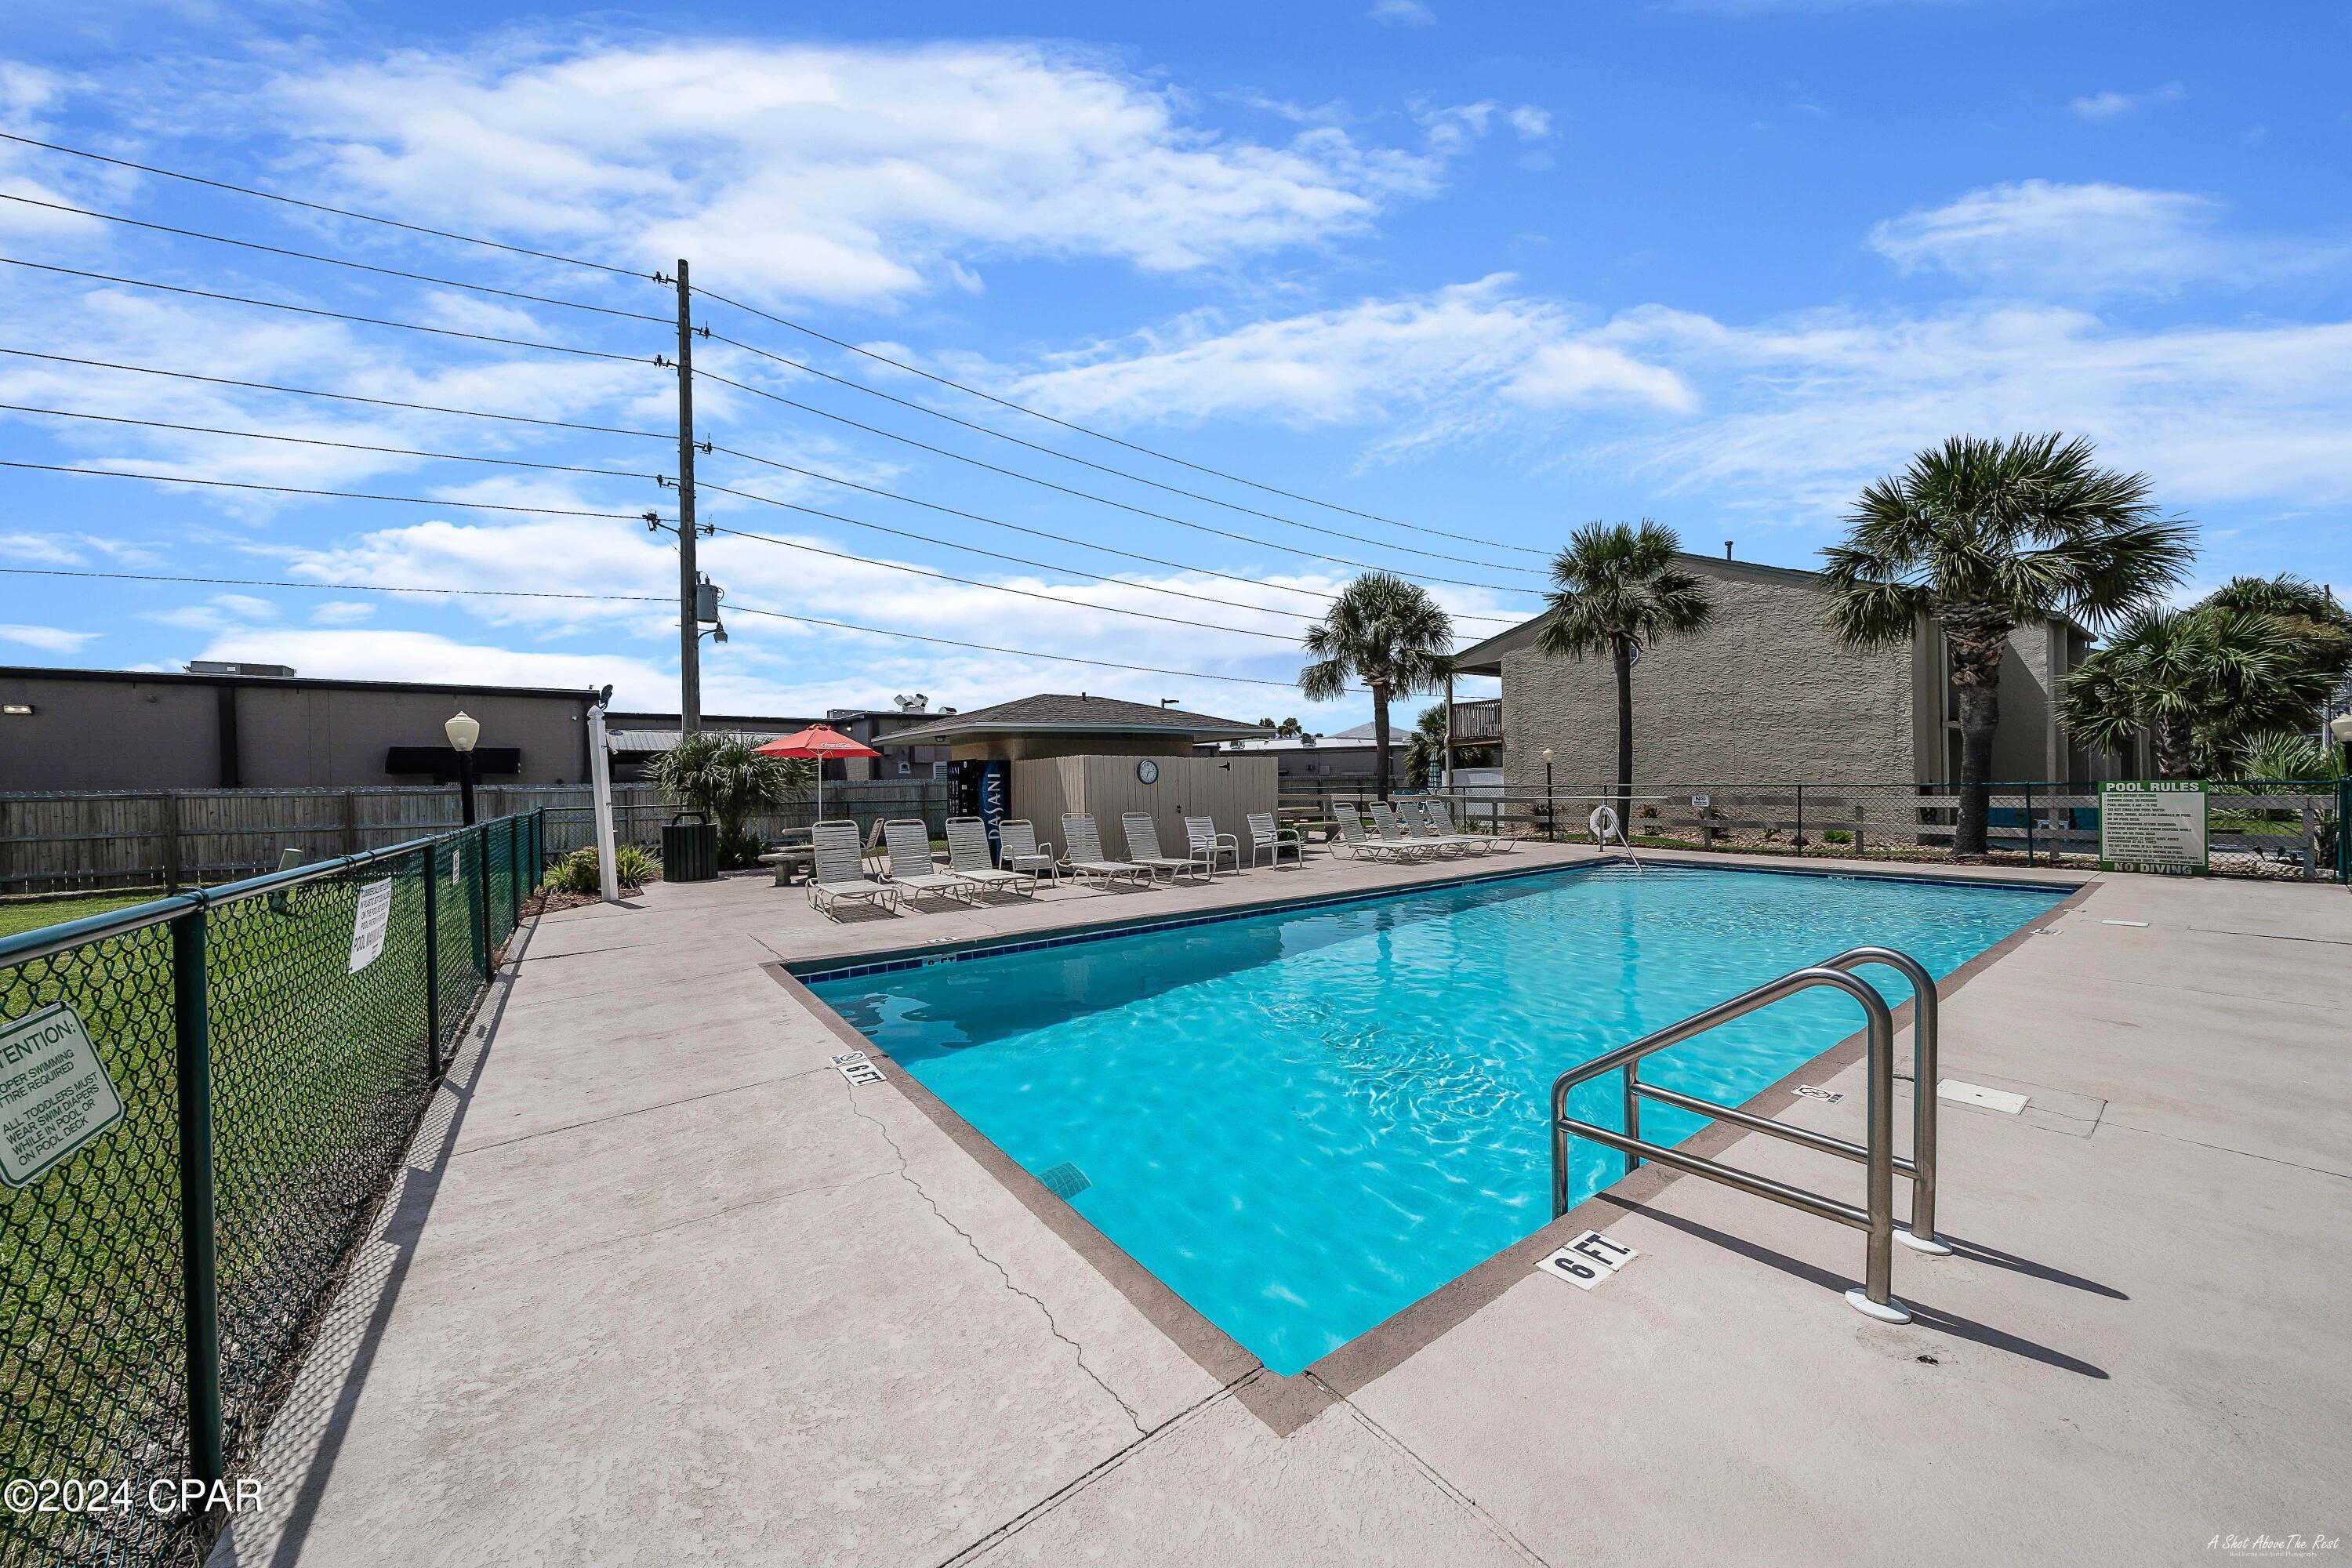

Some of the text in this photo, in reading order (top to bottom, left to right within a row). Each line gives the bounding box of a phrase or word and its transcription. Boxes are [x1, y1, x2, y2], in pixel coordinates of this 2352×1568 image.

[984, 773, 1004, 840] DASANI
[2106, 782, 2199, 792] POOL RULES
[2114, 862, 2192, 875] NO DIVING
[354, 935, 365, 953] POOL
[0, 1049, 74, 1095] OPER SWIMMING
[27, 1061, 74, 1092] REQUIRED
[3, 1071, 98, 1134] ALL TODDLERS MUST
[6, 1083, 100, 1145] WEAR SWIM DIAPERS
[12, 1098, 96, 1156] WHILE IN POOL OR
[19, 1116, 89, 1166] ON POOL DECK
[1554, 1258, 1595, 1279] 6
